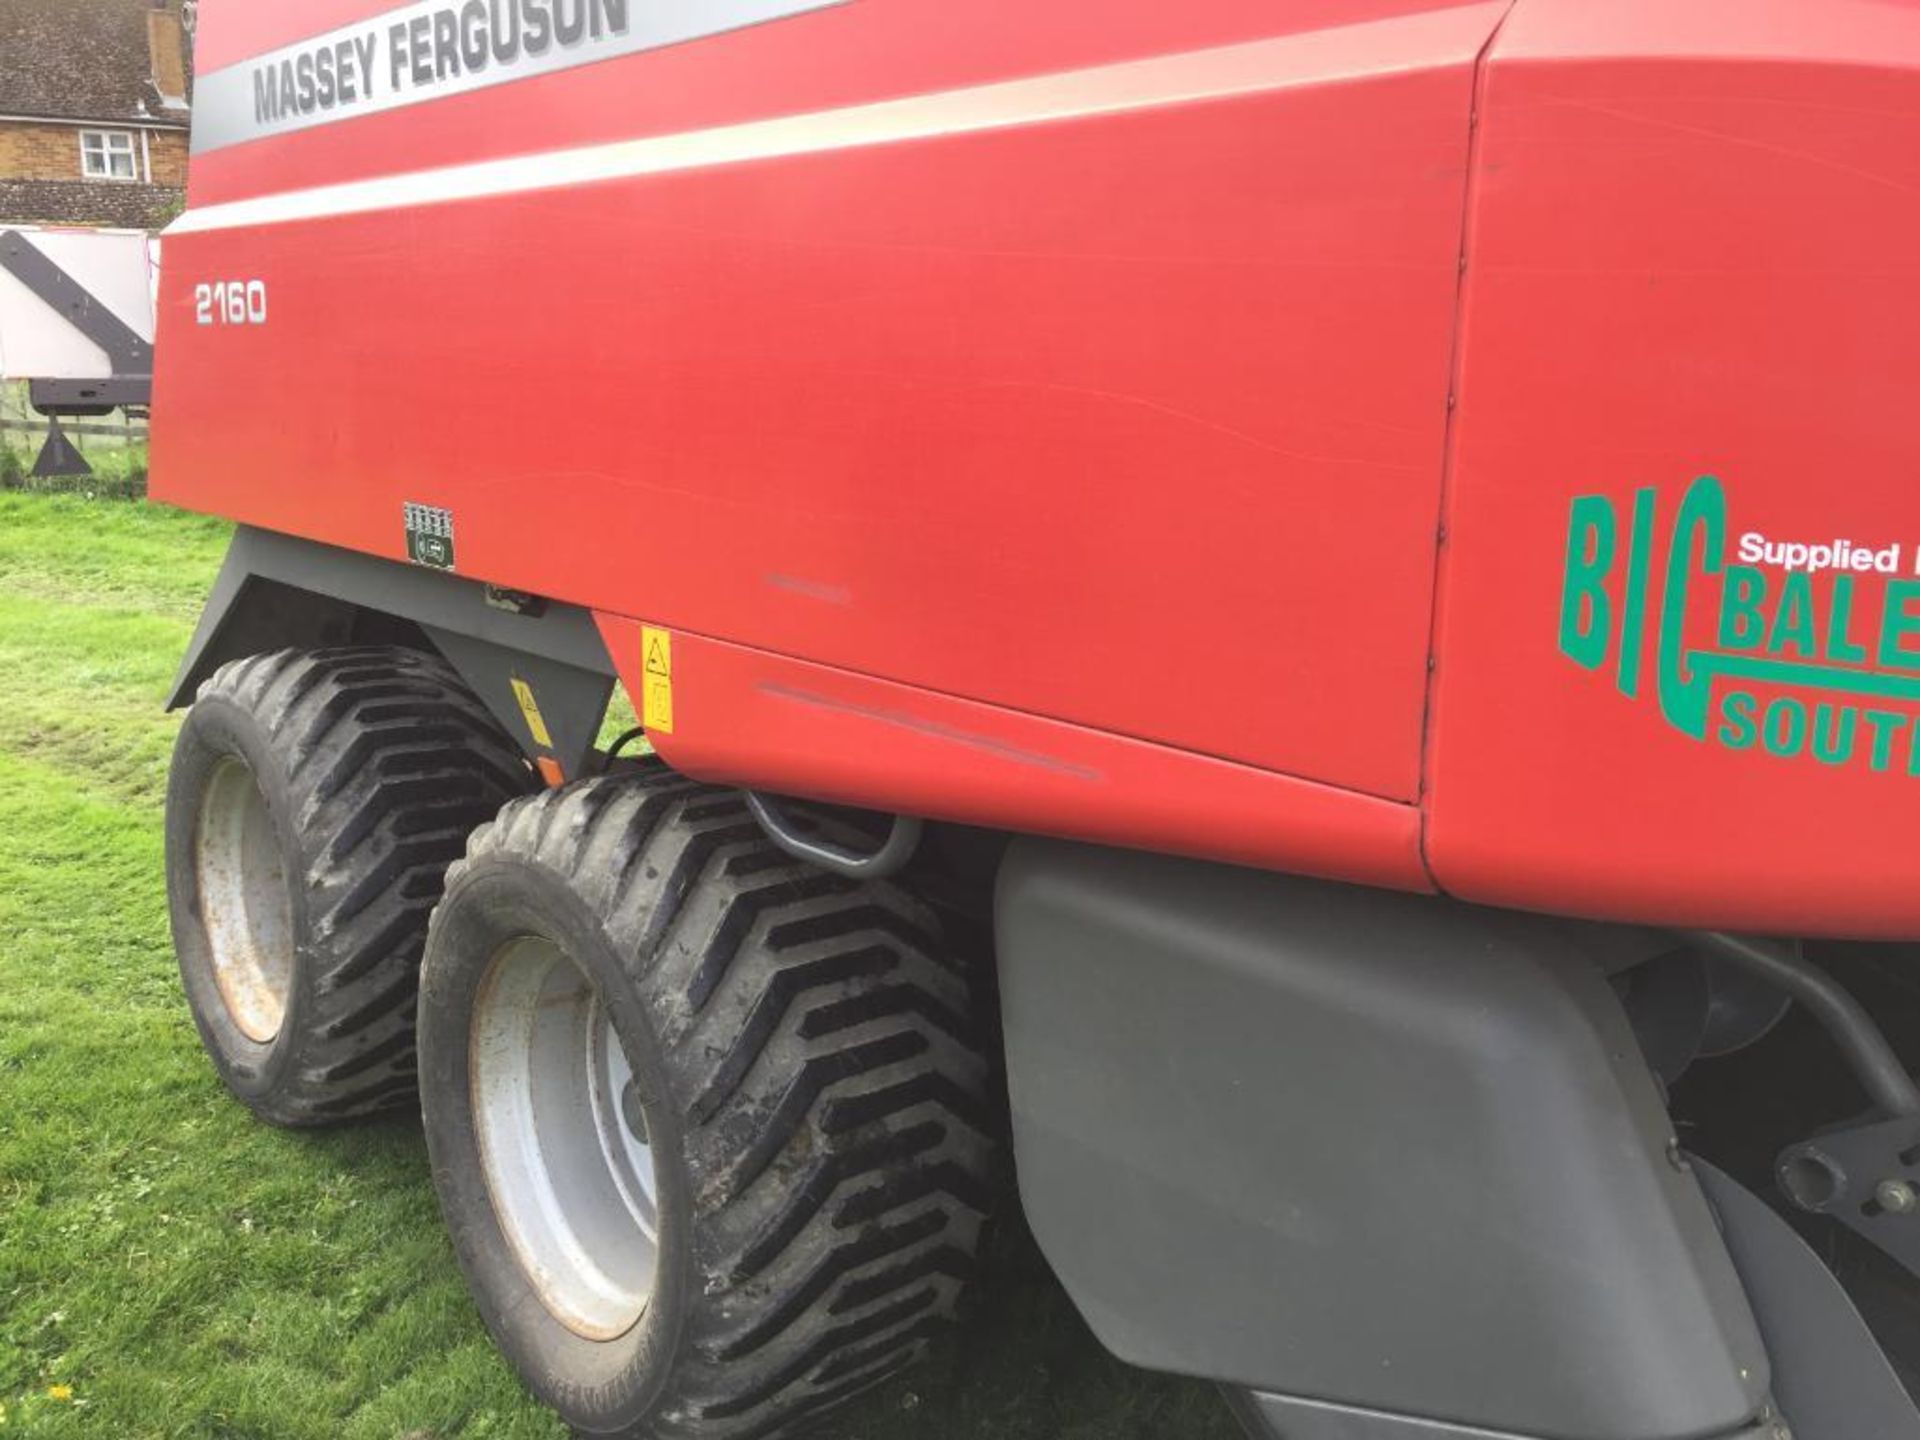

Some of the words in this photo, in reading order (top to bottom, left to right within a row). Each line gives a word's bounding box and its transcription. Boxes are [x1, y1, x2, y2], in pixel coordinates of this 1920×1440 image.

[253, 31, 377, 124] MASSEY
[195, 279, 267, 325] 2160
[1738, 532, 1900, 573] Supplied
[1559, 474, 1727, 742] BIG
